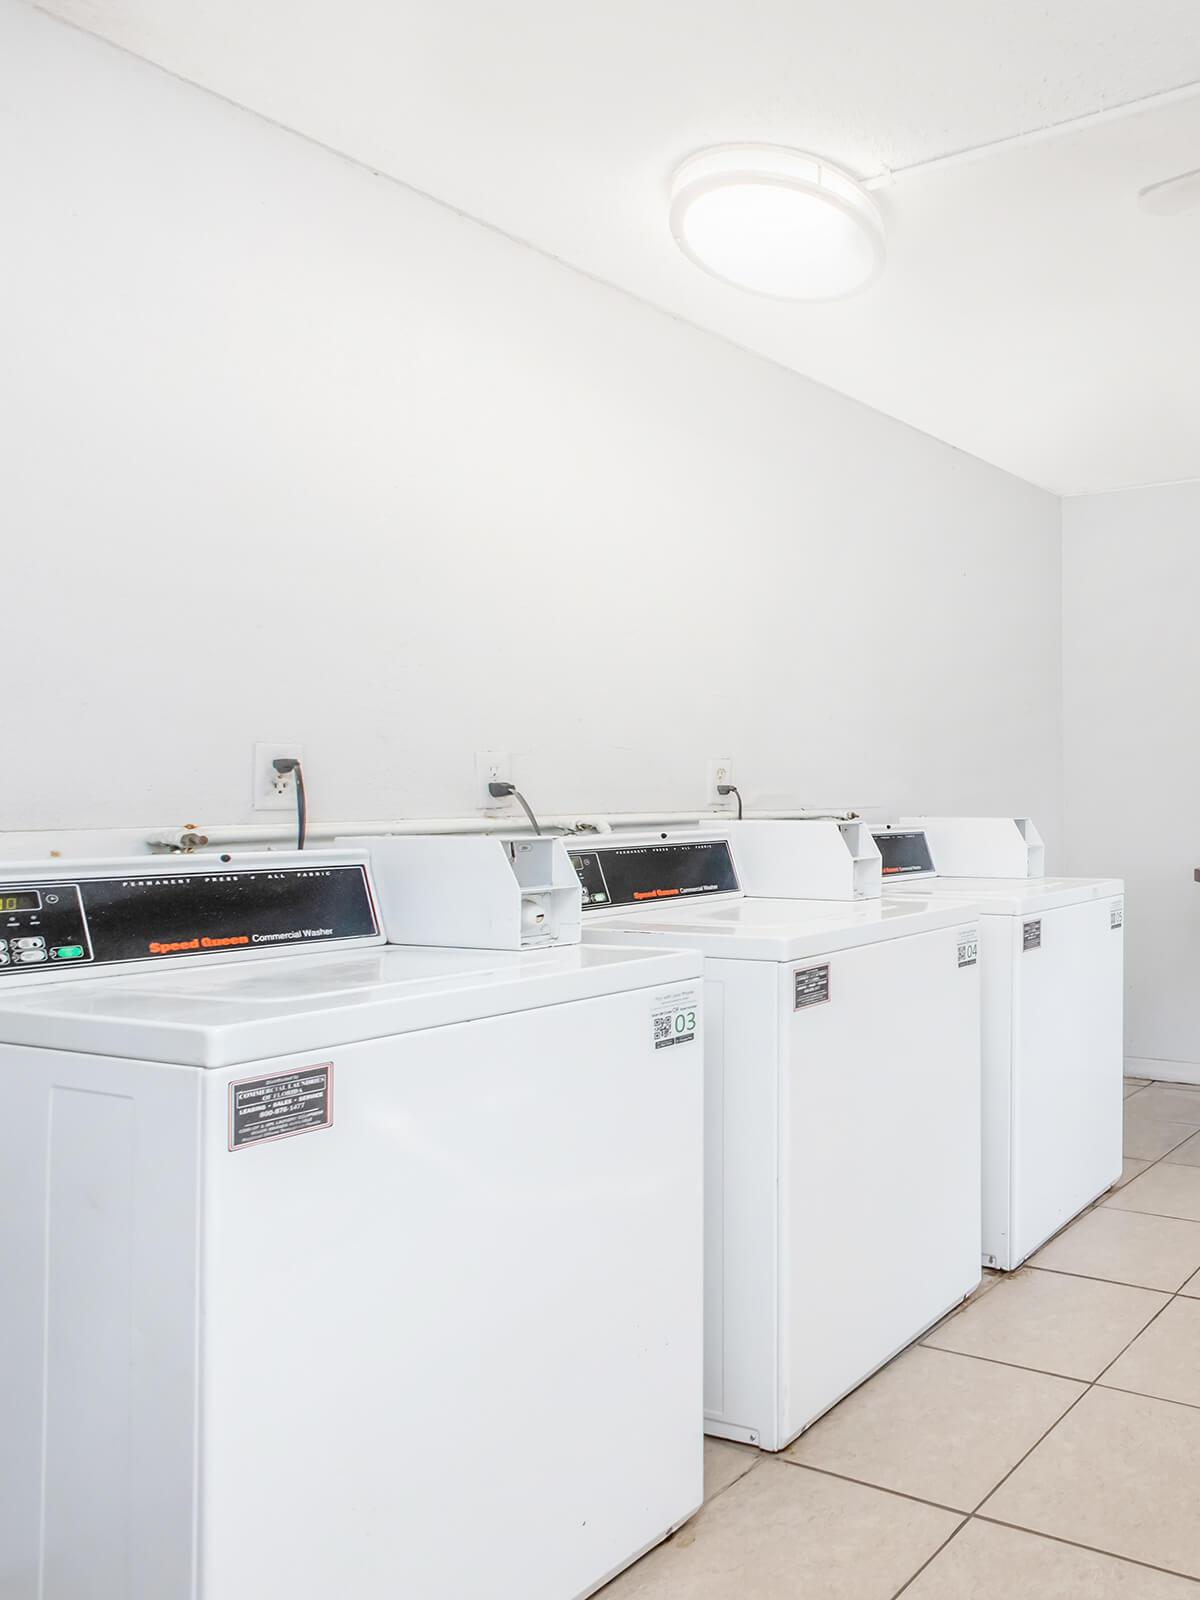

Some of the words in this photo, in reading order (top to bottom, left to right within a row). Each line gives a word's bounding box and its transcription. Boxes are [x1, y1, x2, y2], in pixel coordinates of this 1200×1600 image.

[122, 878, 191, 887] PERMANENT
[252, 930, 302, 942] Commercial
[303, 928, 333, 937] Washer
[148, 939, 199, 954] Speed
[201, 936, 249, 947] Queen
[967, 944, 977, 958] 04
[675, 1011, 696, 1033] 03
[239, 1086, 287, 1099] COMMERCIAL
[288, 1078, 324, 1089] LAUNDRIES
[273, 1088, 303, 1098] FLORIDA
[239, 1104, 267, 1115] LEASING
[273, 1099, 292, 1108] SALES
[298, 1092, 324, 1102] SERVICE
